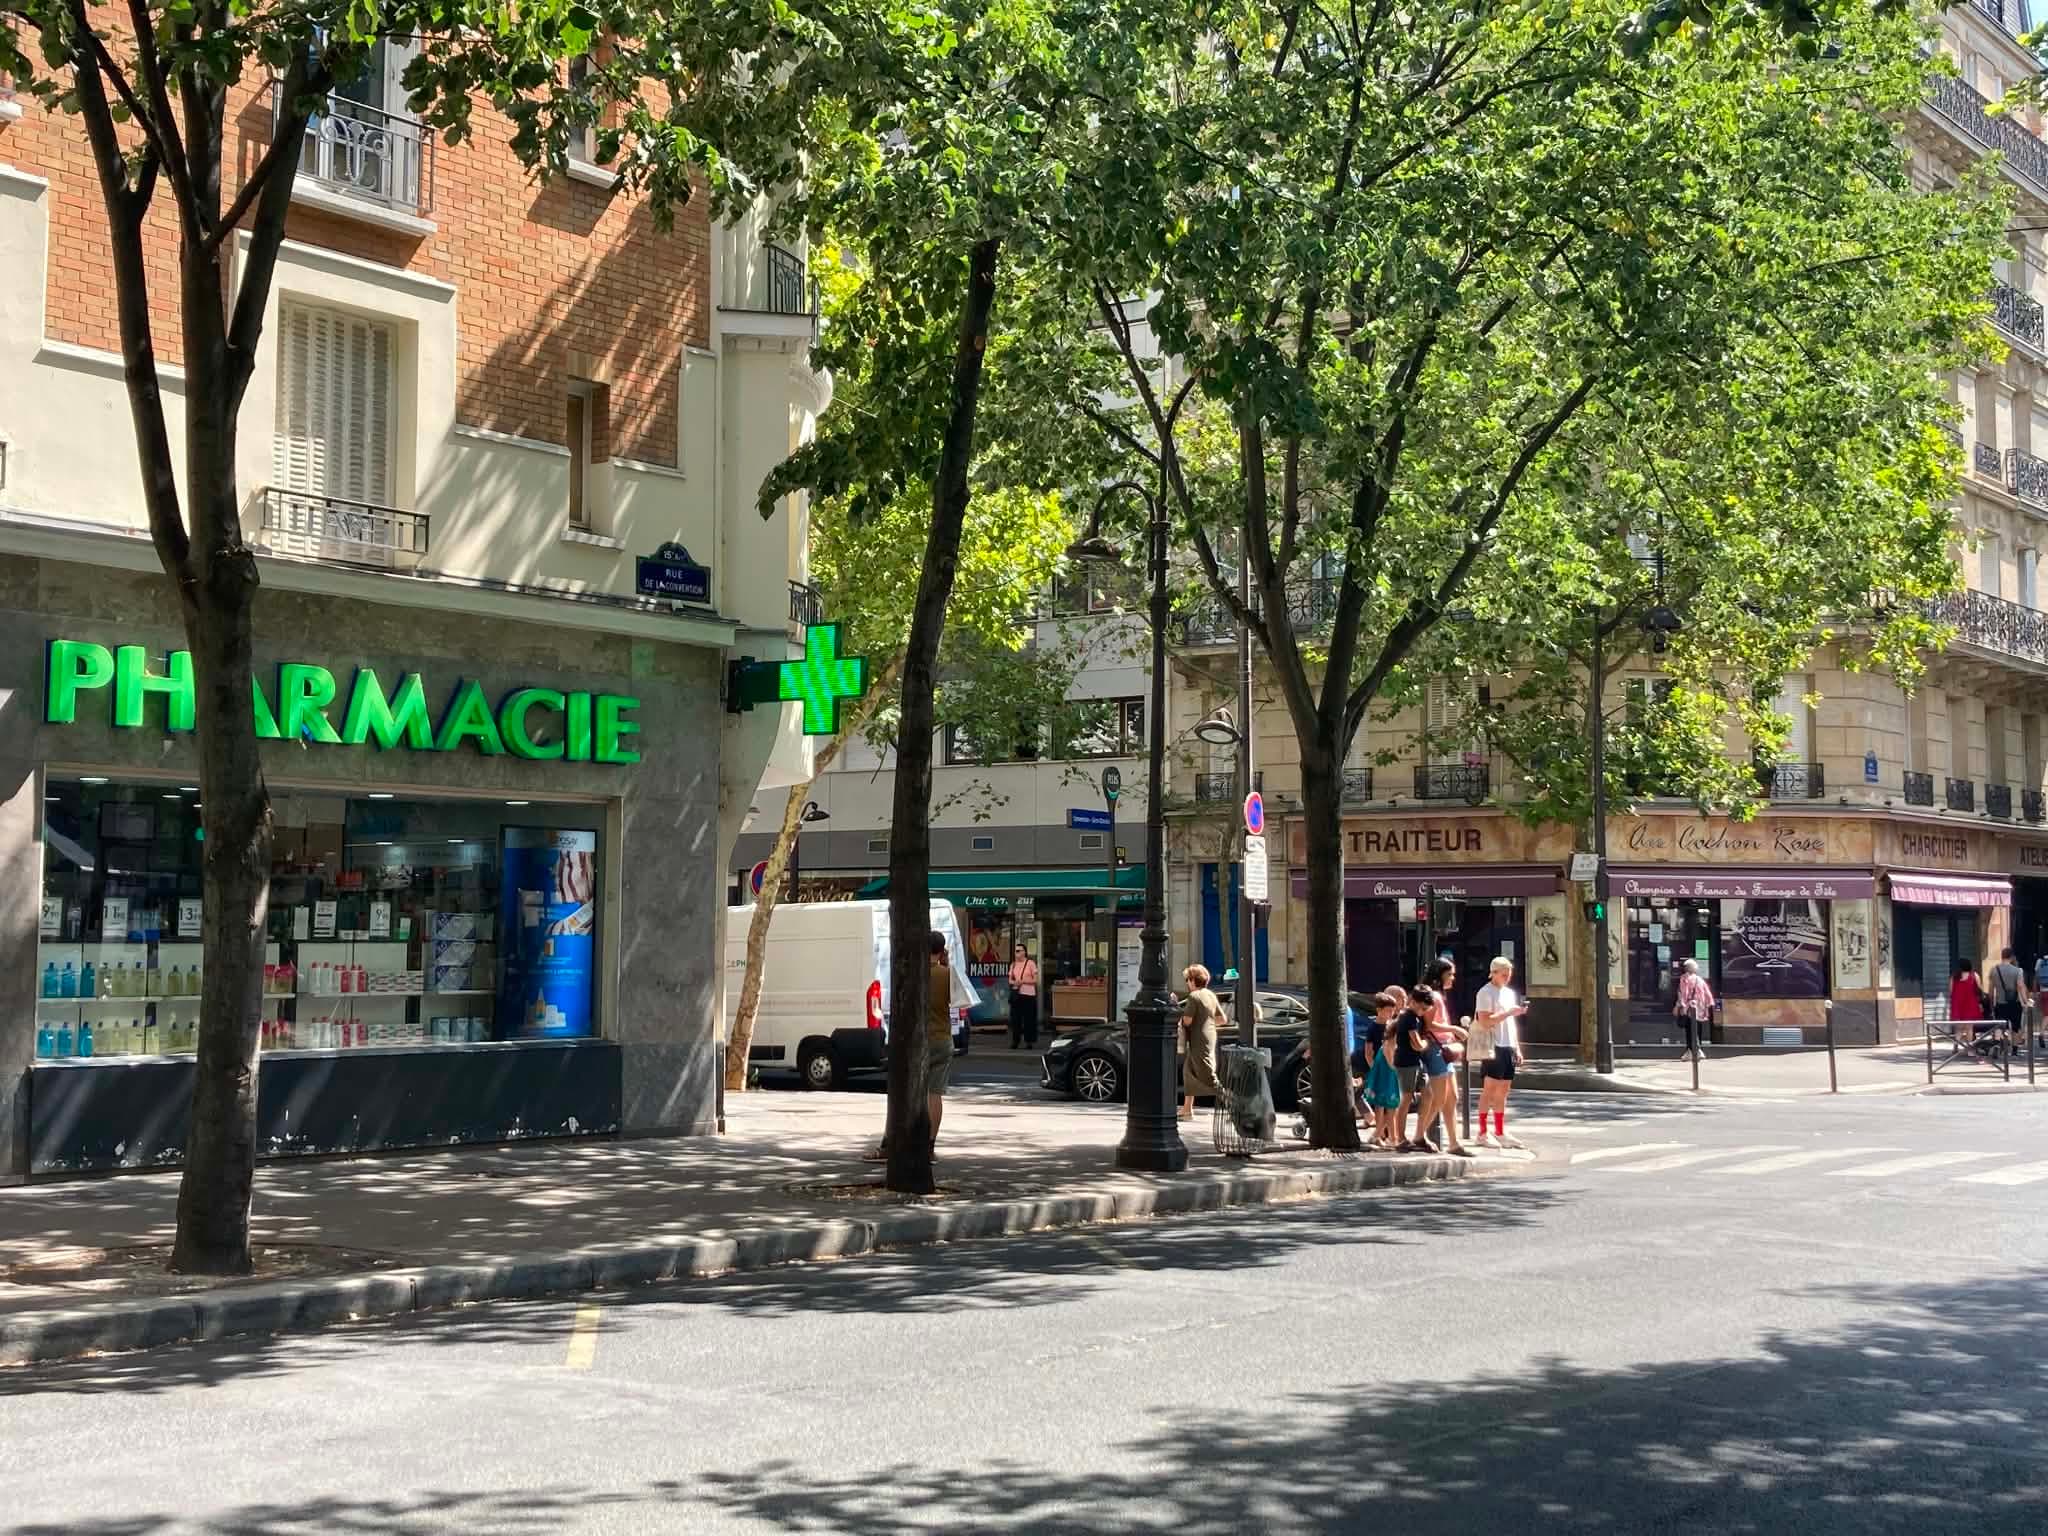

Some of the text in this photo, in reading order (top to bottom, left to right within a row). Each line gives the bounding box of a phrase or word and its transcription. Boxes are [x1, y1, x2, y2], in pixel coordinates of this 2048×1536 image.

[665, 568, 684, 580] RUE
[644, 577, 655, 589] DE
[665, 581, 704, 595] CONVENTION
[1348, 828, 1482, 853] TRAITEUR
[1679, 823, 1762, 853] Cochon
[1772, 825, 1825, 856] Rose
[1902, 833, 1968, 861] CHARCUTIER
[1373, 882, 1407, 896] Artisan
[1624, 879, 1676, 897] Champion
[1694, 881, 1729, 896] France
[1752, 882, 1797, 899] Fromage
[970, 962, 1009, 977] MARTINI
